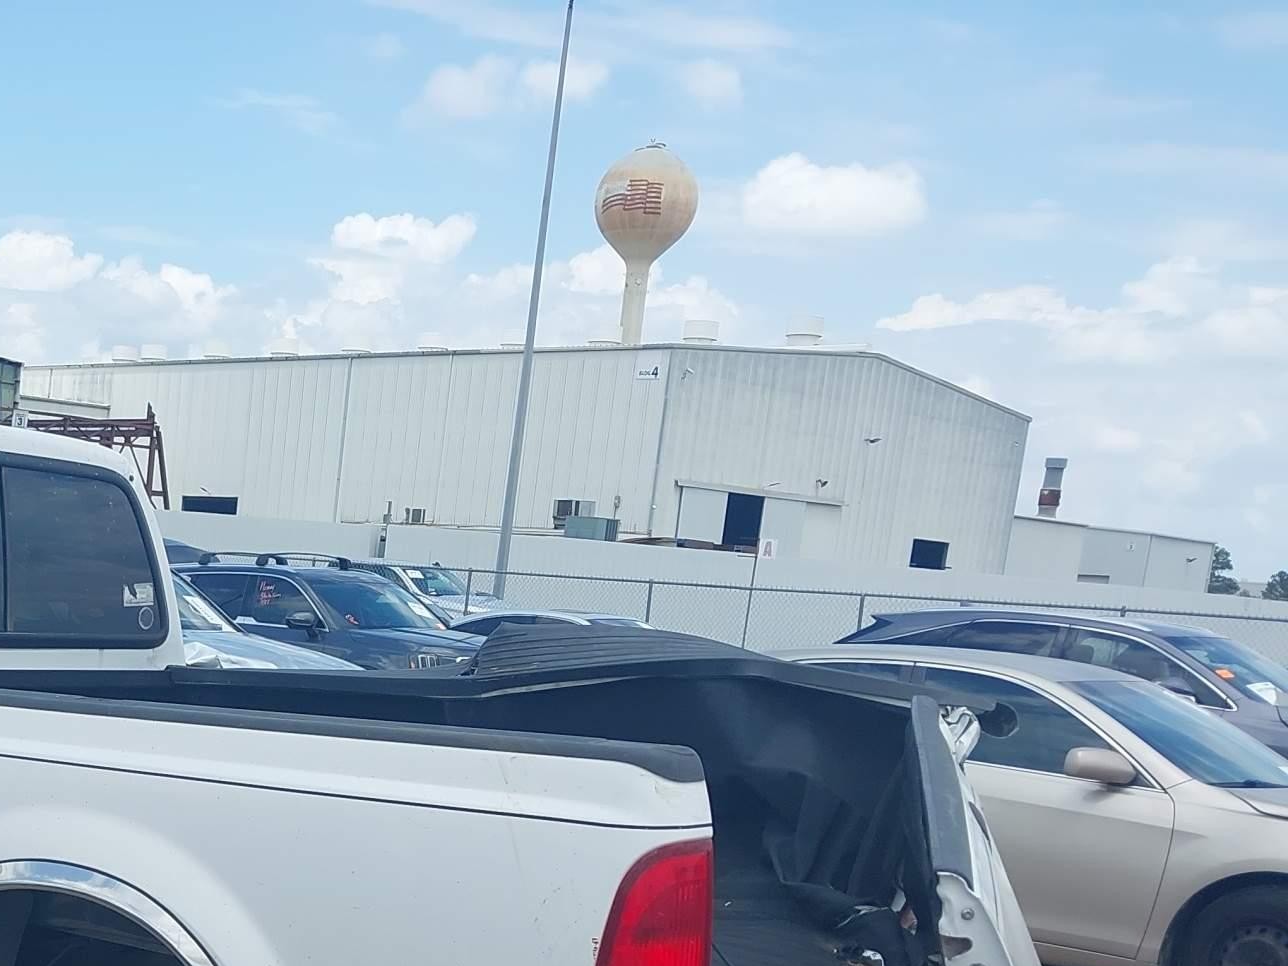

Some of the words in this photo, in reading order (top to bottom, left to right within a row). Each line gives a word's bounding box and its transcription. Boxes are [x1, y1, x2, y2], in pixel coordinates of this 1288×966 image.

[651, 366, 659, 378] 4
[17, 417, 23, 426] 3
[762, 541, 773, 557] A
